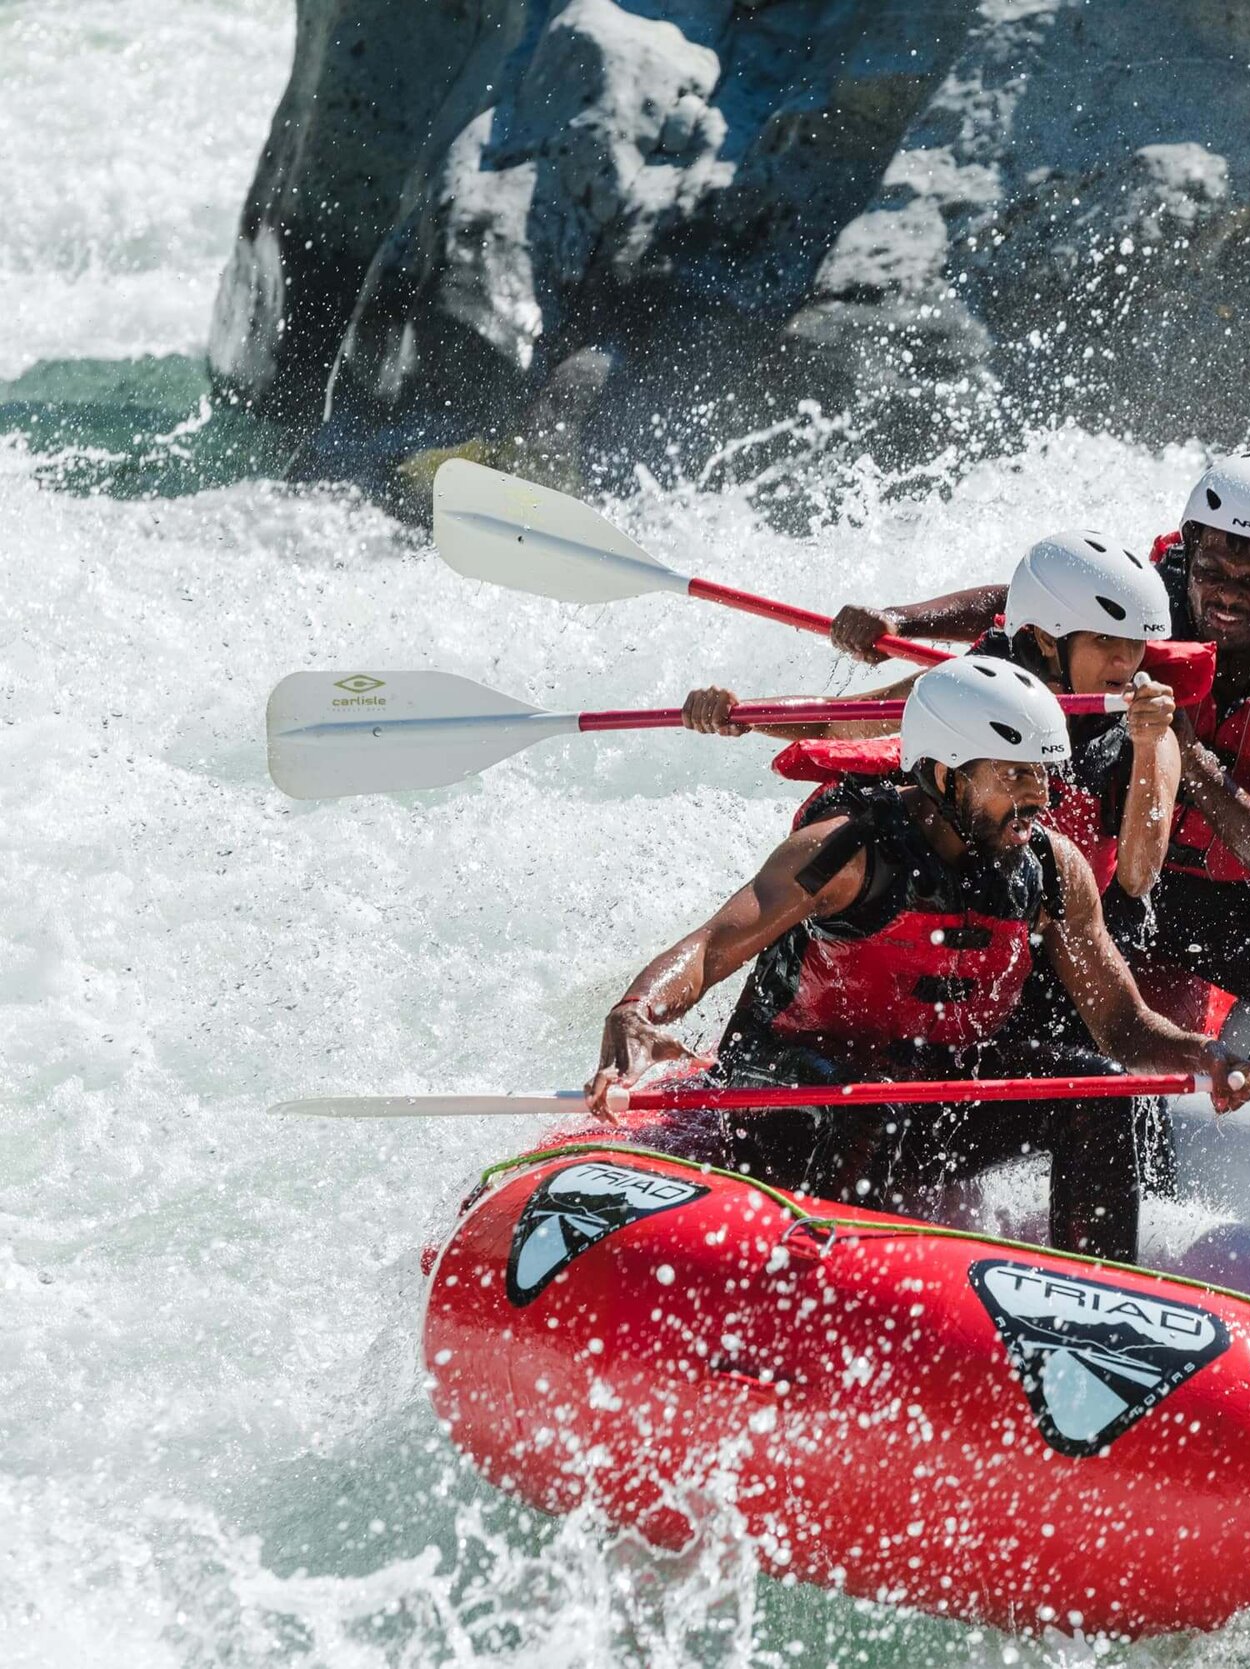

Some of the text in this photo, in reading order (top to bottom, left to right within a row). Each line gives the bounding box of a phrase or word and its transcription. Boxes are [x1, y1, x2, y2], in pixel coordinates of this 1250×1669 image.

[1143, 624, 1165, 632] NRS
[332, 695, 386, 706] carlisle
[1042, 744, 1064, 754] NRS
[577, 1165, 688, 1199] TRIAD
[997, 1270, 1202, 1336] TRIAD
